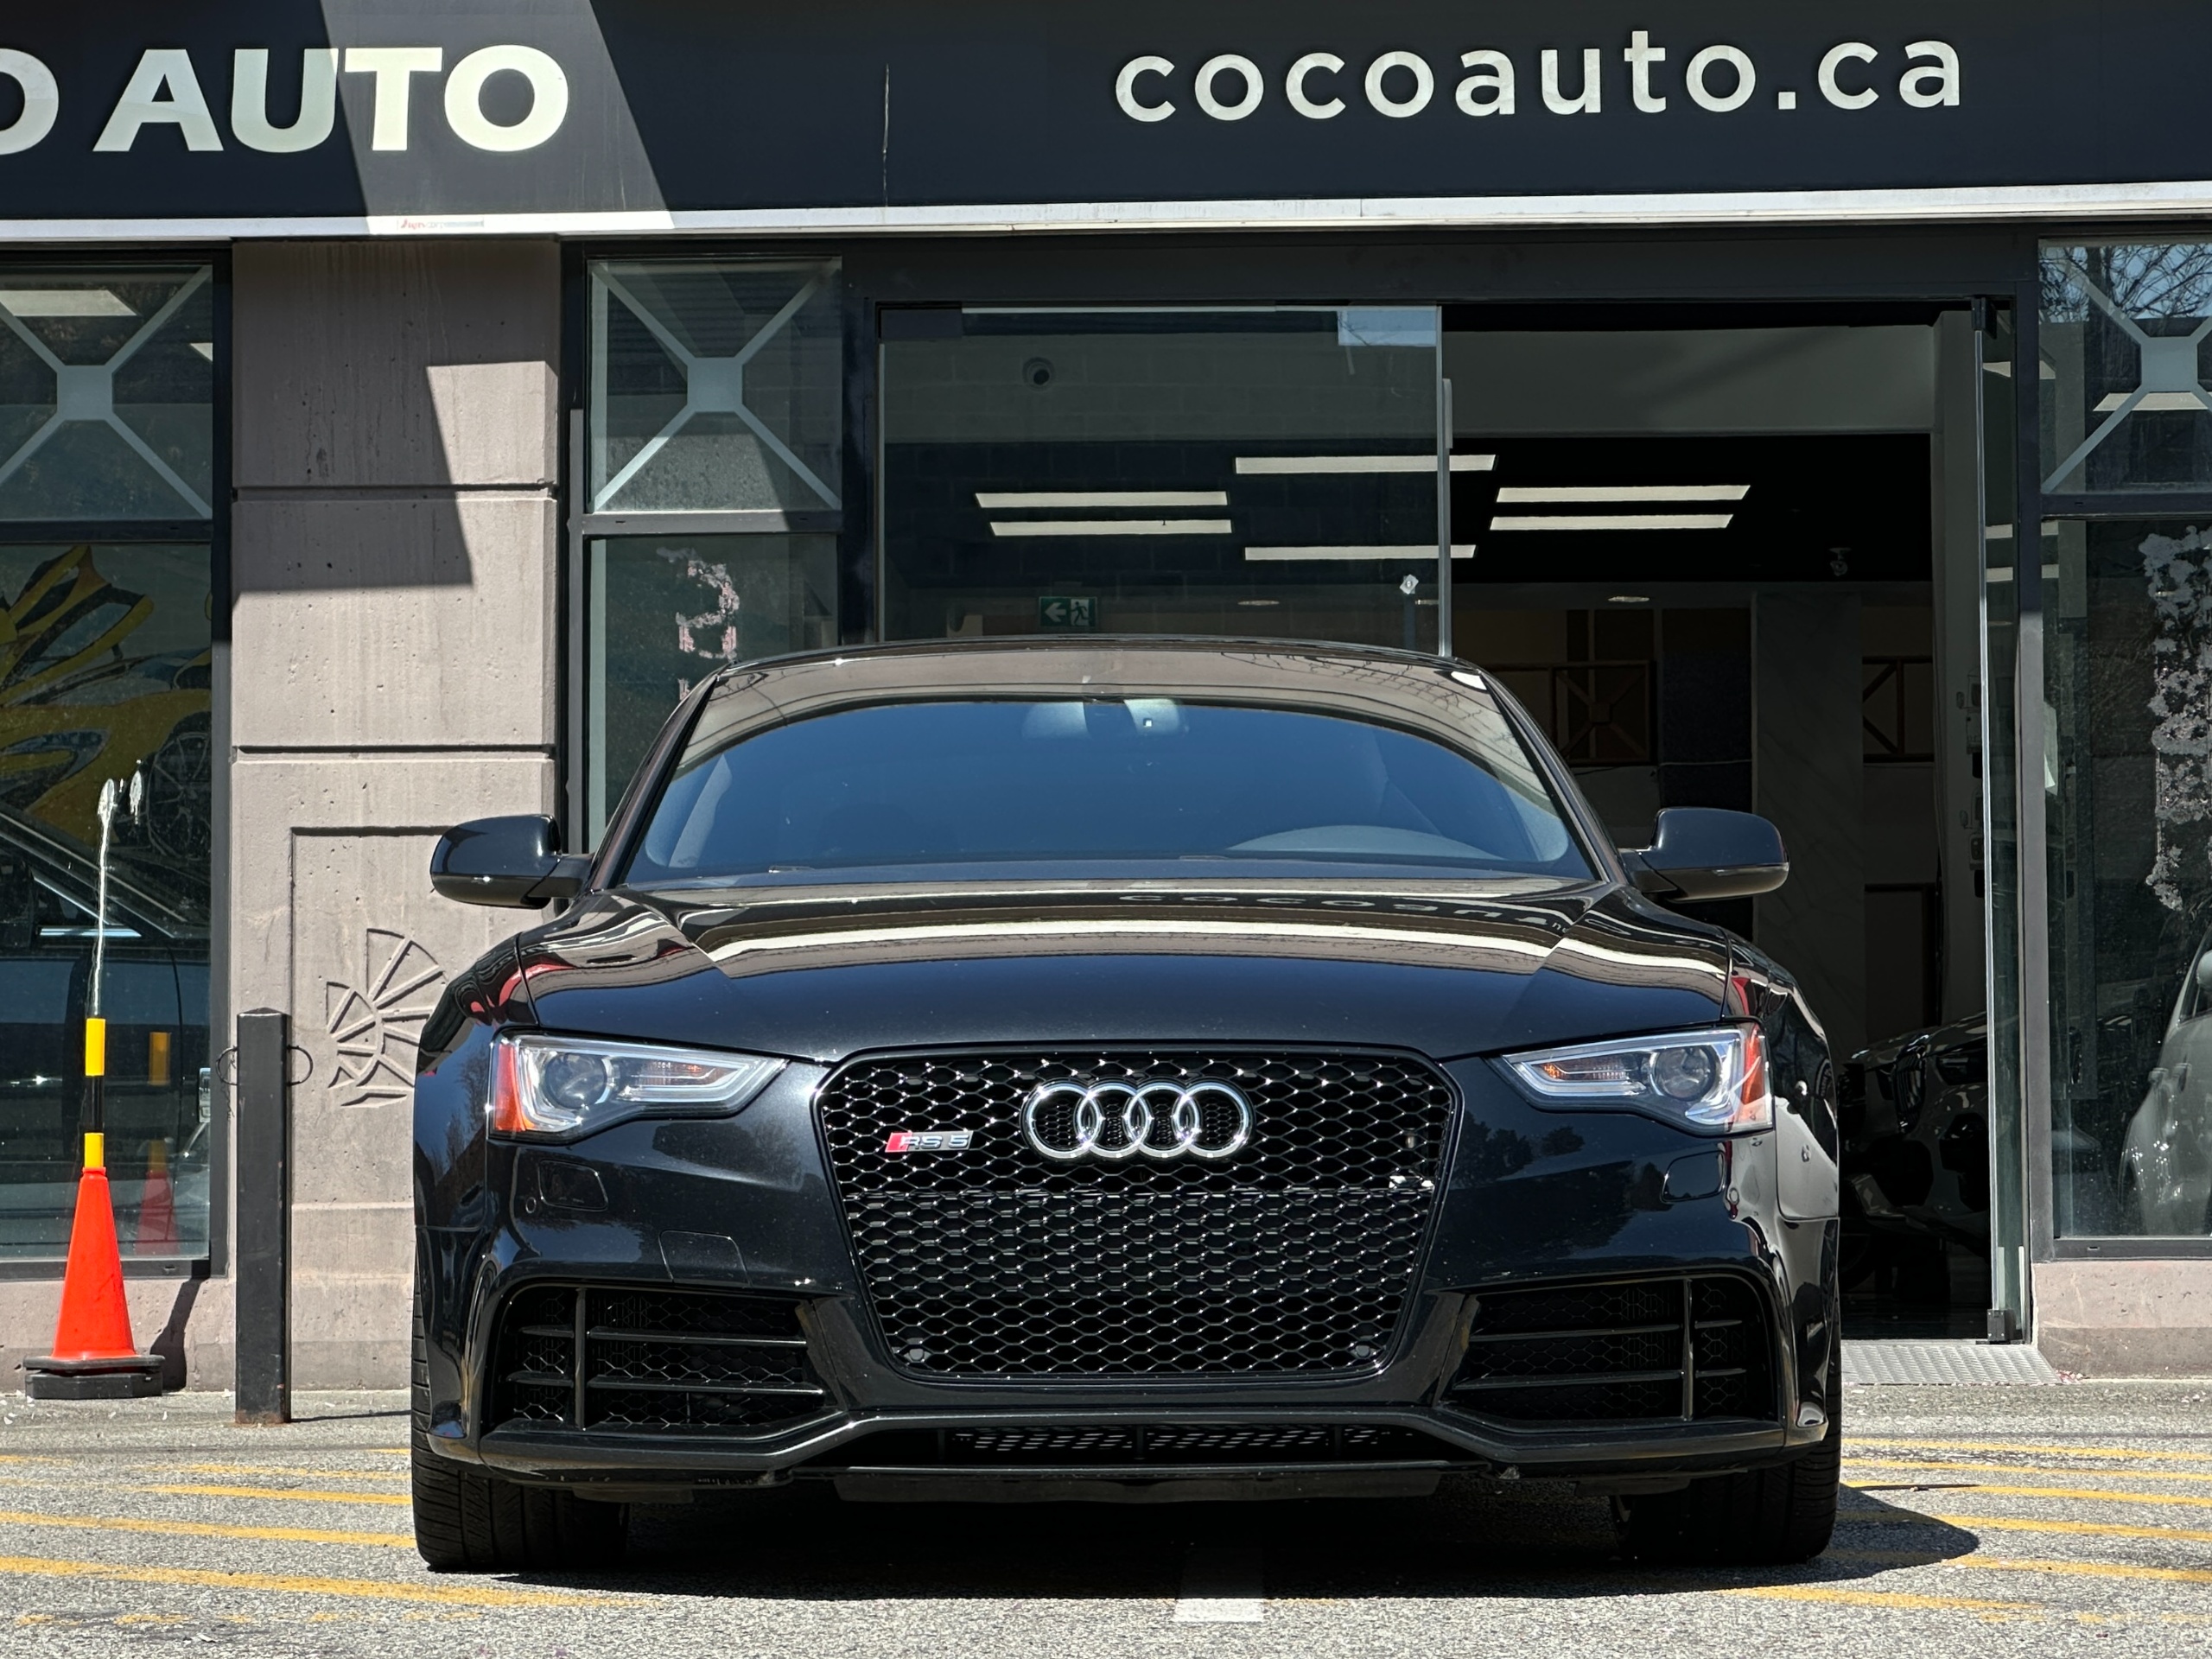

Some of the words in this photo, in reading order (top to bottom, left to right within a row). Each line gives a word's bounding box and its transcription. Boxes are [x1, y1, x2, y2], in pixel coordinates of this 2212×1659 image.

[92, 44, 569, 154] AUTO
[1115, 30, 1961, 123] cocoauto.ca
[899, 1135, 943, 1149] RS
[948, 1134, 969, 1148] 5
